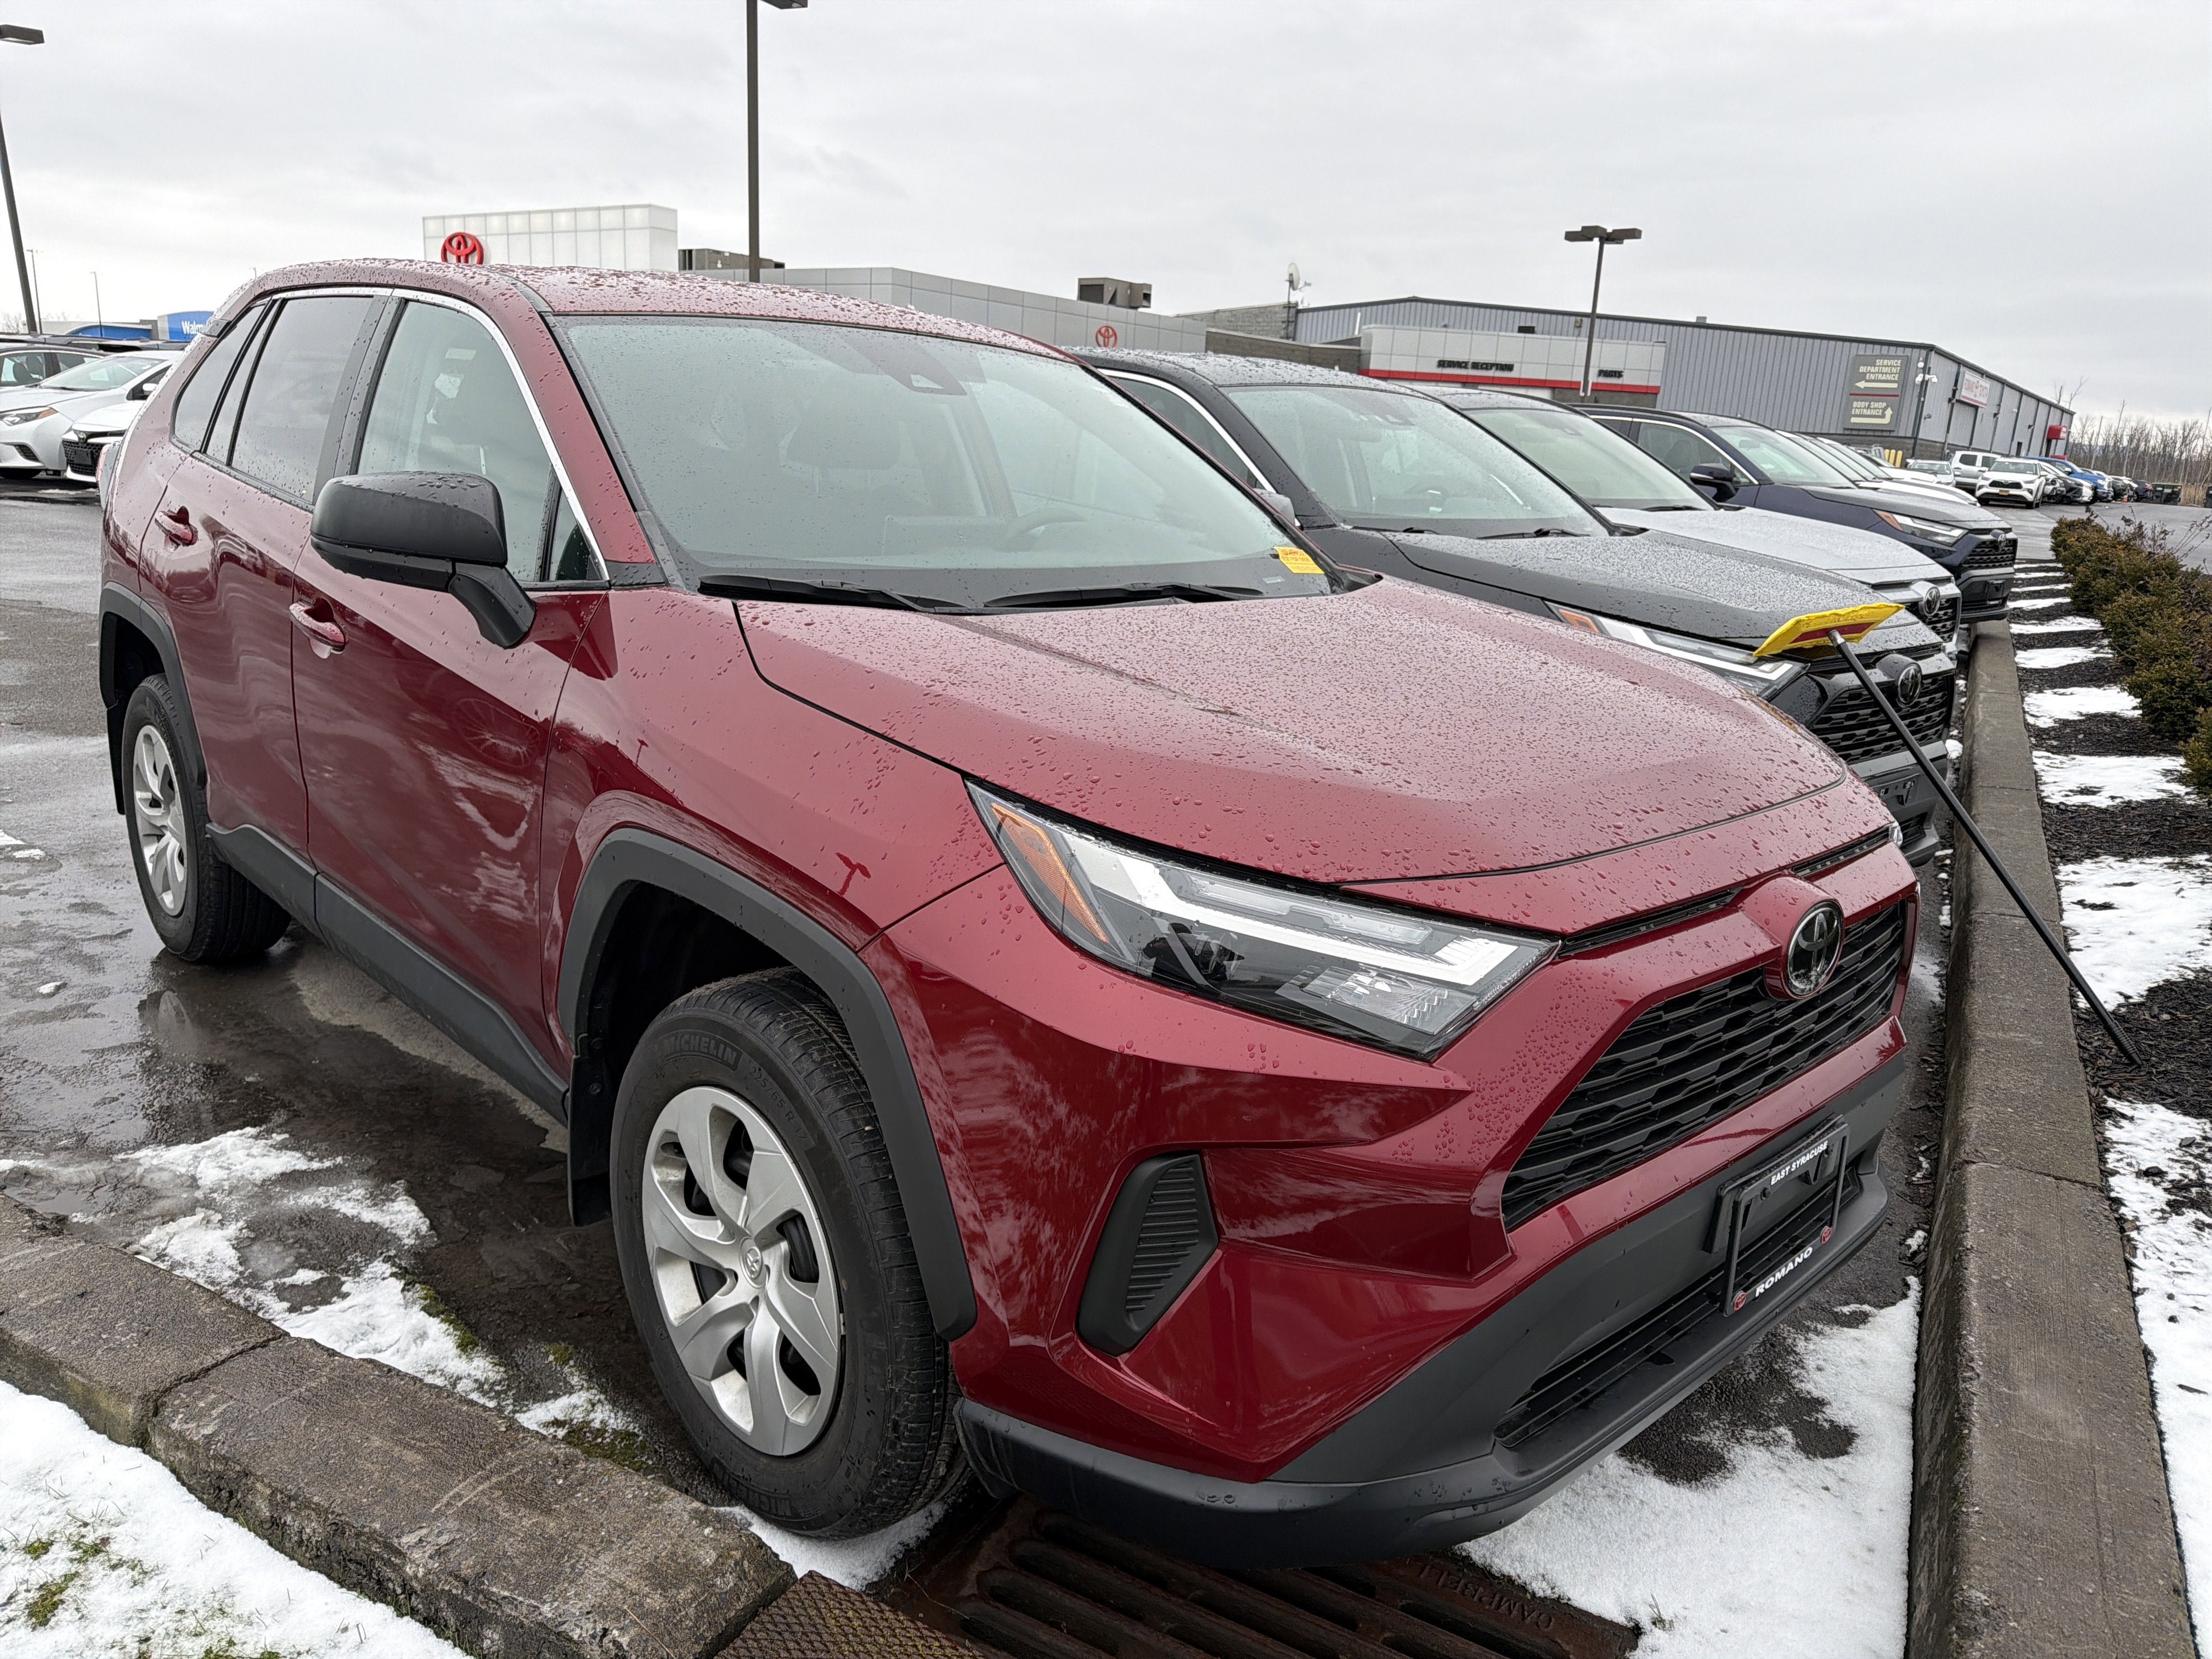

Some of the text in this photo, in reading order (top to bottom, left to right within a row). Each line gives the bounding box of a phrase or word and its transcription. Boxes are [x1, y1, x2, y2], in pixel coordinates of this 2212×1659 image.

[182, 321, 203, 334] Walm
[664, 1034, 738, 1065] MICHELIN
[750, 1066, 786, 1108] 225/65
[785, 1111, 794, 1122] R
[1771, 1141, 1828, 1185] EAST SYRACUSE
[1755, 1246, 1813, 1297] ROMANO
